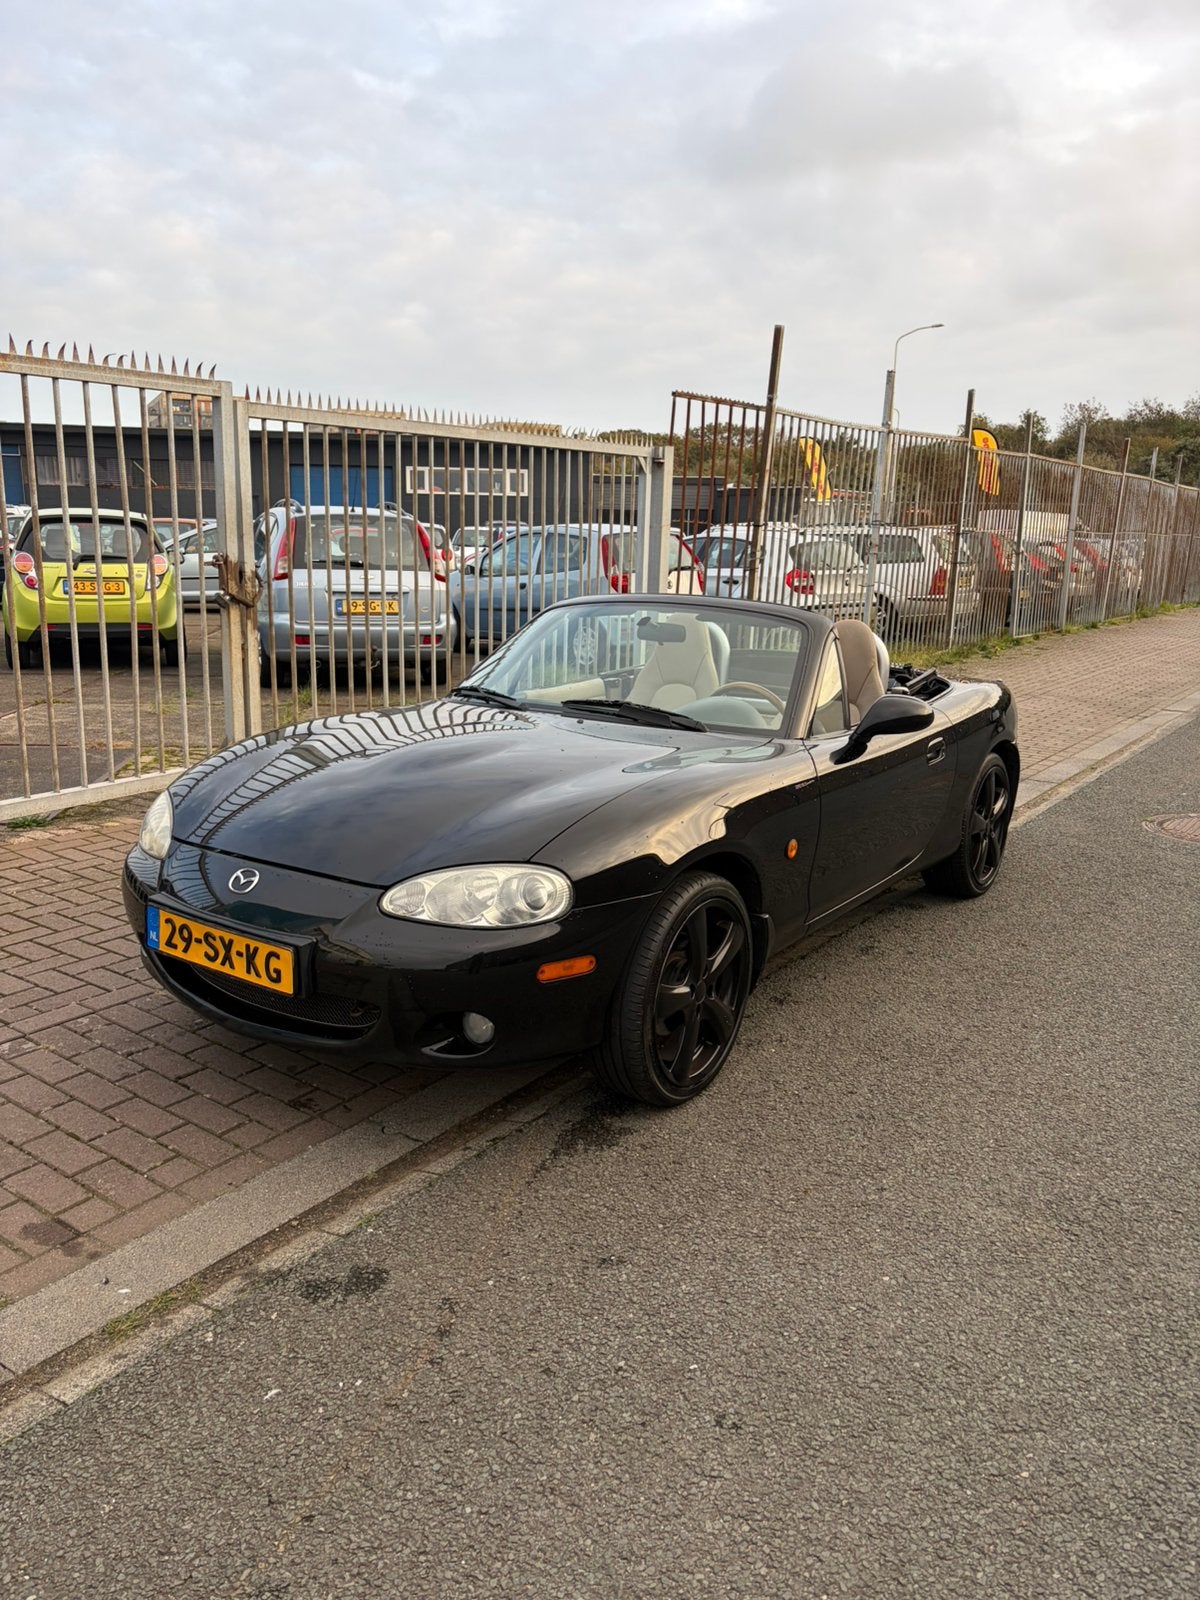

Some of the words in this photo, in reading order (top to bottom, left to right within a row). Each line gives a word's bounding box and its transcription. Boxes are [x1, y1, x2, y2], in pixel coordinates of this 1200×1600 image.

[73, 582, 121, 592] 43-SG-3
[347, 601, 395, 611] 9-SG-K
[164, 918, 282, 984] 29-SX-KG
